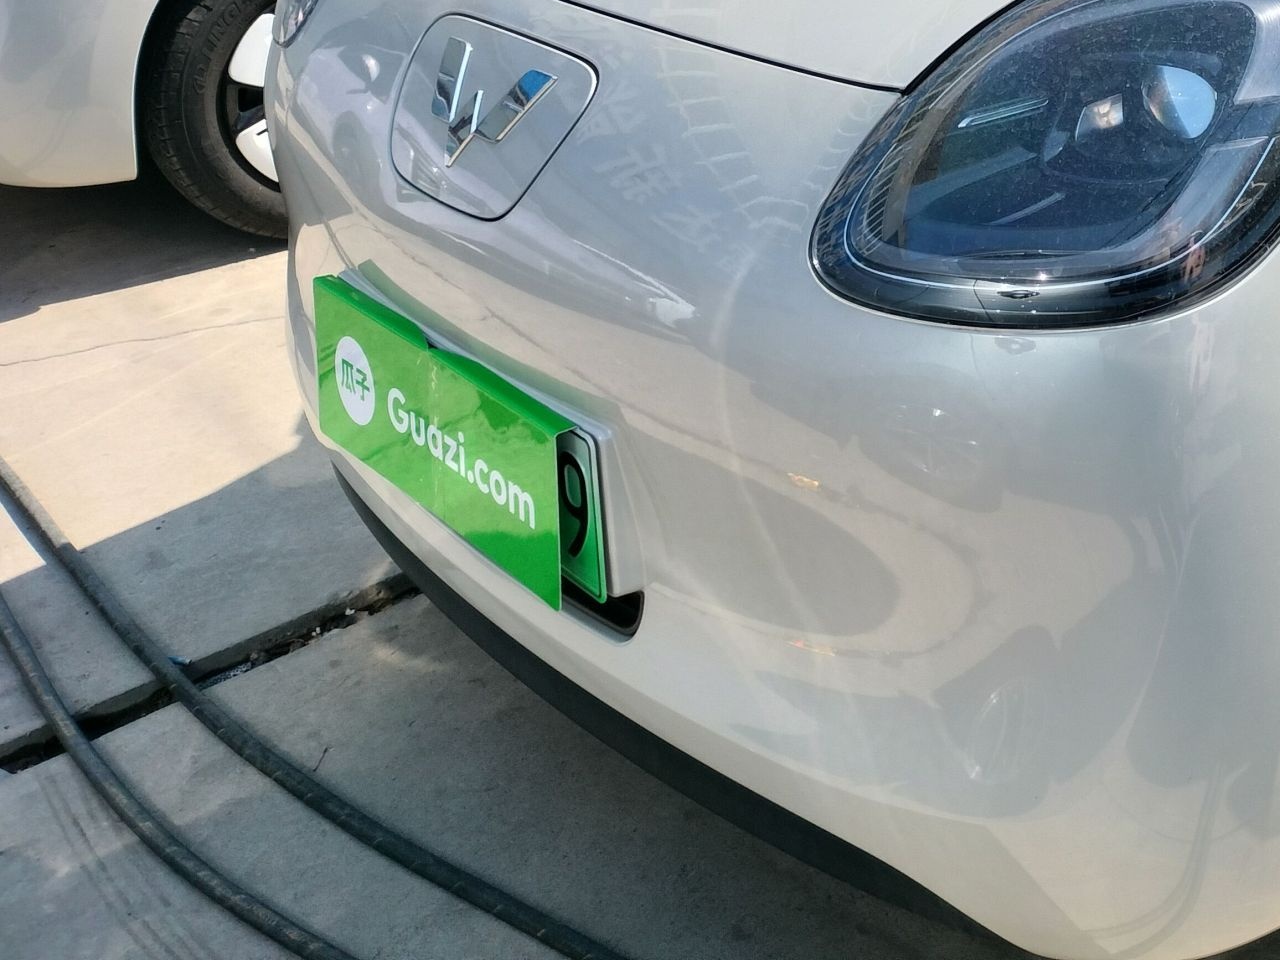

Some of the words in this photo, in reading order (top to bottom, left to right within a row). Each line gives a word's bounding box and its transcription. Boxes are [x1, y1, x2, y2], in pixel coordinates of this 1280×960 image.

[340, 358, 371, 402] 瓜子
[387, 387, 535, 530] Guazi.com
[558, 451, 589, 558] 9
